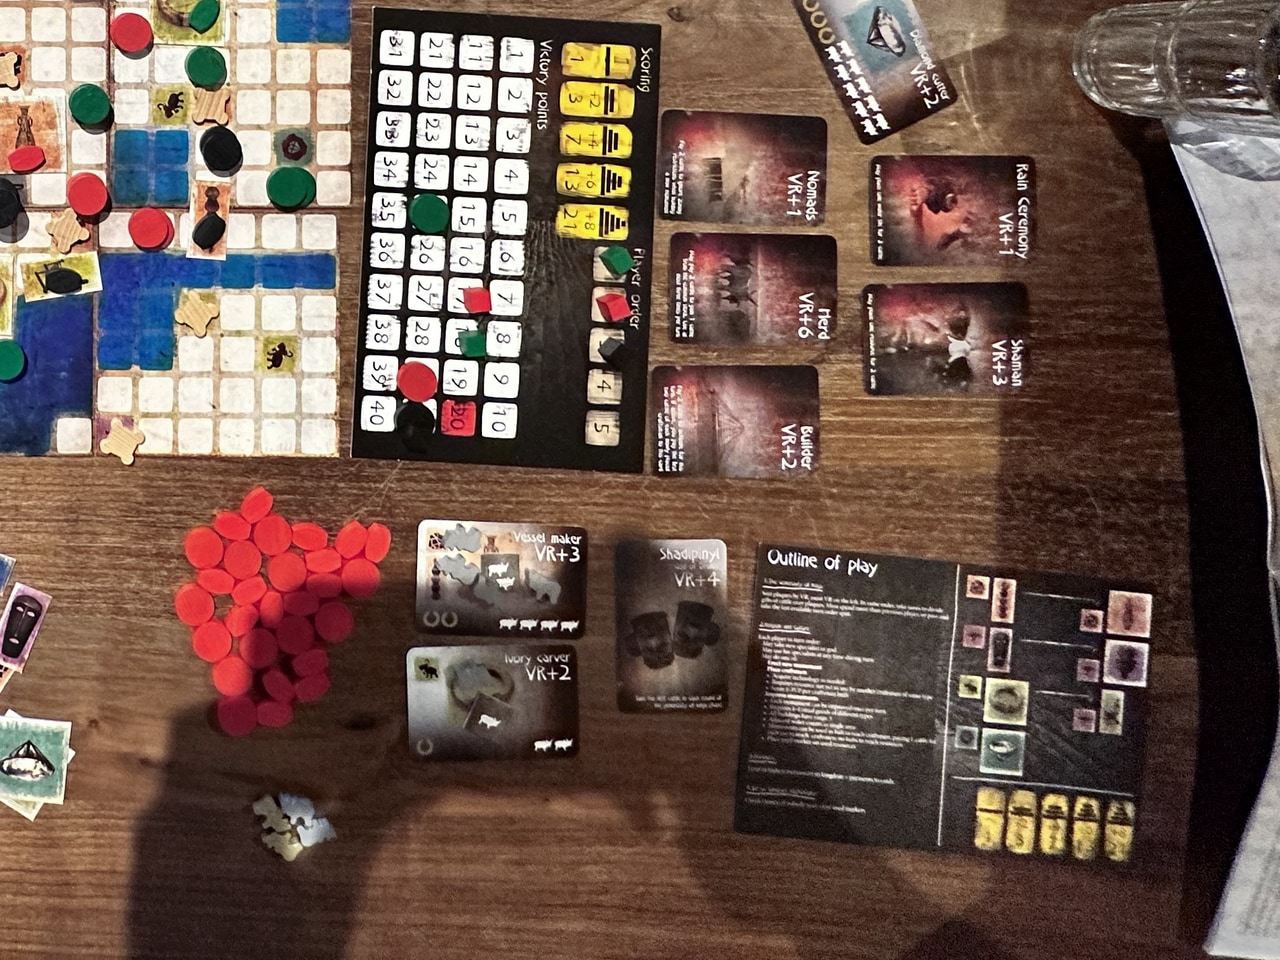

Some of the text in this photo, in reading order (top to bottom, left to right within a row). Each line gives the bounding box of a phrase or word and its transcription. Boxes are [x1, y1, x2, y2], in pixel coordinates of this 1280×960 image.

[429, 37, 443, 59] 21
[468, 42, 483, 62] 11
[636, 46, 654, 93] Scoring
[909, 29, 950, 100] Diamond cutter
[386, 76, 402, 100] 32
[426, 78, 442, 102] 22
[466, 82, 481, 105] 12
[507, 89, 522, 101] 2
[535, 39, 553, 131] Victory points
[910, 62, 939, 109] VR+2
[568, 93, 583, 105] 3
[589, 91, 601, 109] +2
[425, 118, 440, 142] 23
[464, 122, 480, 145] 13
[506, 130, 521, 141] 3
[565, 132, 582, 145] 7
[588, 131, 599, 149] +4
[382, 156, 398, 182] 34
[423, 157, 438, 183] 24
[463, 163, 478, 186] 14
[504, 169, 519, 182] 4
[565, 169, 580, 191] 13
[586, 171, 596, 189] +6
[786, 173, 804, 216] VR+1
[805, 170, 820, 221] Nomads
[379, 197, 395, 223] 35
[460, 204, 476, 227] 15
[501, 211, 517, 224] 5
[563, 208, 578, 230] 21
[584, 213, 596, 230] +8
[1014, 163, 1030, 260] Rain Ceremony
[998, 212, 1014, 256] VR+1
[378, 238, 394, 263] 36
[418, 239, 434, 264] 26
[458, 244, 474, 267] 16
[500, 251, 516, 264] 6
[375, 279, 392, 304] 37
[415, 281, 432, 306] 27
[497, 292, 514, 305] 7
[798, 292, 815, 339] VR+6
[817, 308, 831, 340] Herd
[373, 319, 390, 344] 38
[414, 321, 431, 346] 28
[496, 332, 512, 344] 8
[371, 361, 387, 386] 39
[991, 339, 1008, 386] VR+3
[1011, 339, 1023, 388] Shaman
[451, 367, 468, 389] 19
[493, 373, 509, 385] 9
[596, 379, 612, 393] 4
[369, 400, 385, 426] 40
[450, 404, 466, 430] 20
[491, 409, 507, 433] 10
[593, 421, 610, 434] 5
[781, 423, 798, 471] VR+2
[800, 425, 814, 470] Builder
[512, 531, 582, 545] Vessel maker
[535, 545, 581, 562] VR+3
[767, 548, 878, 578] Outline of play
[674, 571, 721, 587] VR+4
[504, 652, 570, 666] Ivory carver
[526, 664, 571, 681] VR+2
